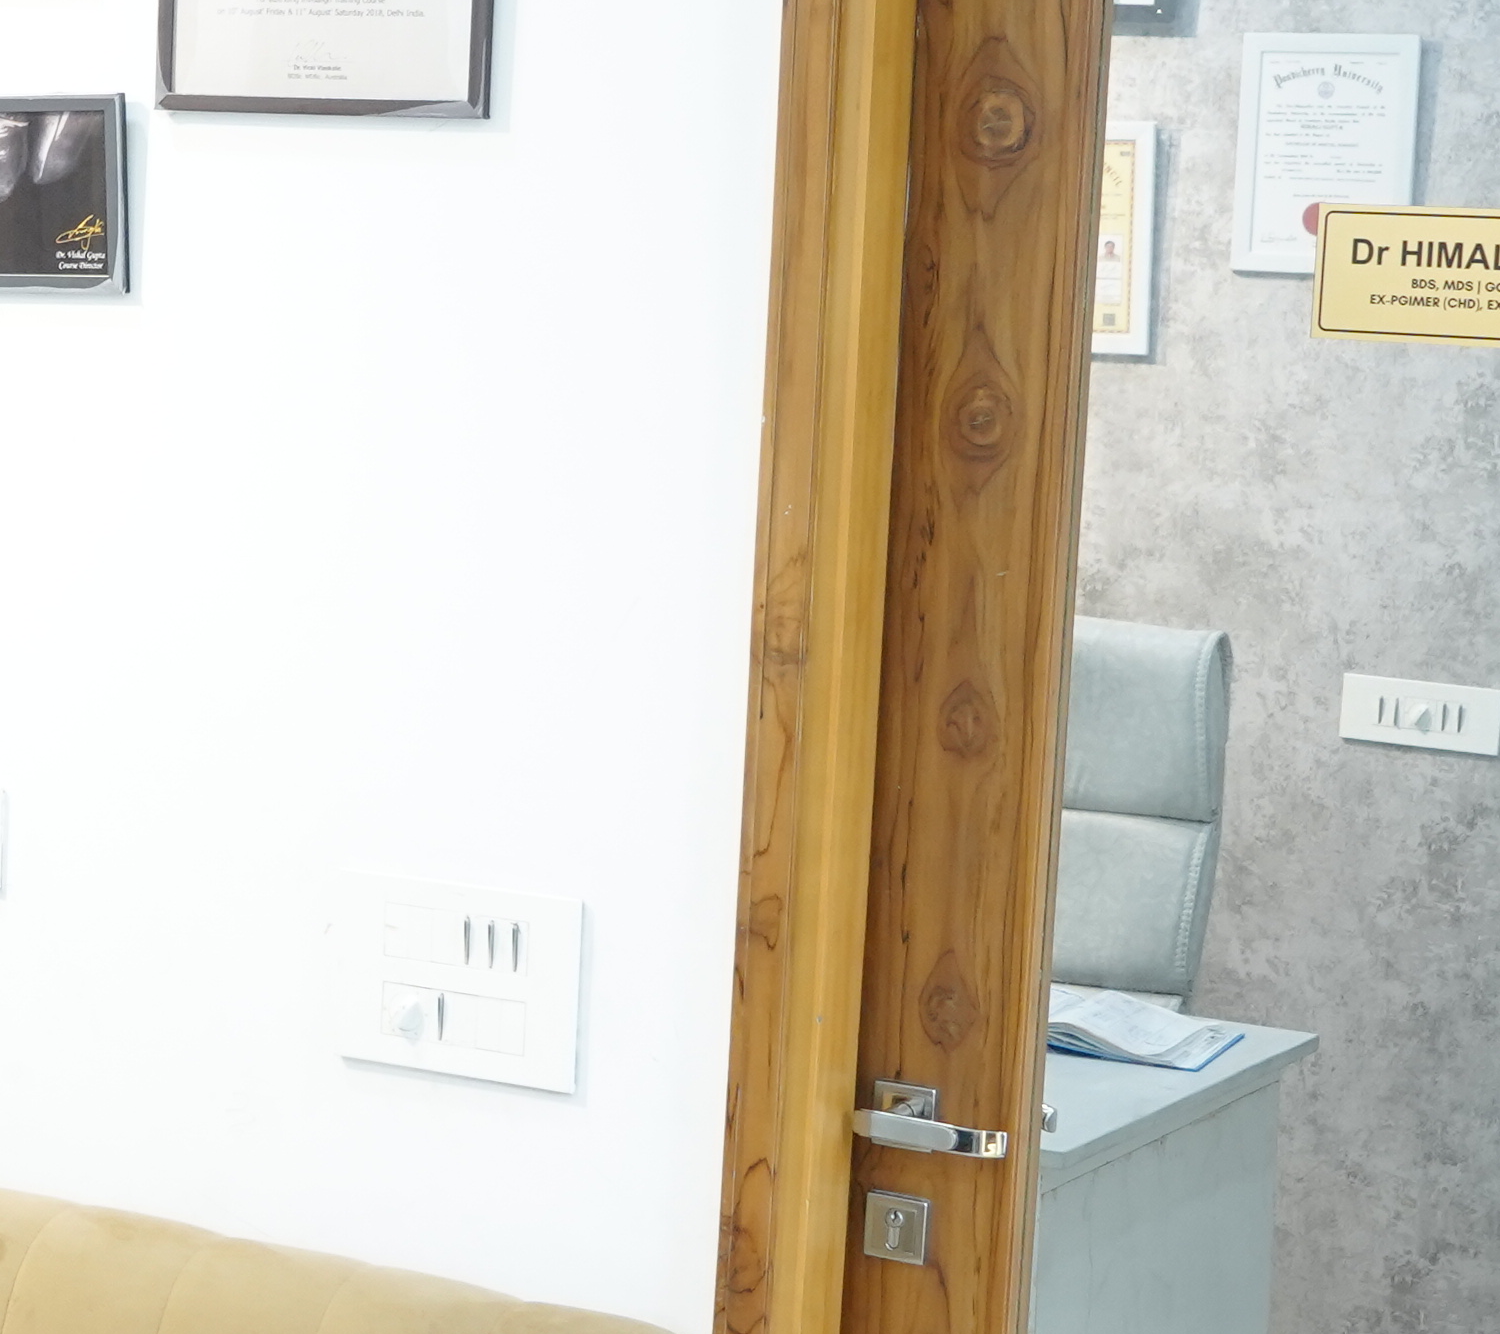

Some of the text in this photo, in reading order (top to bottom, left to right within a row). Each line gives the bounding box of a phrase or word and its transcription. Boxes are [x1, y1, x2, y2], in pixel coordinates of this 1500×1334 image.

[335, 8, 364, 18] Saturday
[386, 8, 404, 17] Delhi
[1334, 64, 1384, 94] University
[87, 252, 105, 261] Gupta
[1351, 238, 1389, 265] Dr
[58, 262, 78, 270] Course
[1410, 278, 1440, 292] BDS,
[1443, 279, 1474, 292] MDS
[1369, 294, 1440, 308] EX-PGIMER
[1443, 296, 1483, 312] (CHD),
